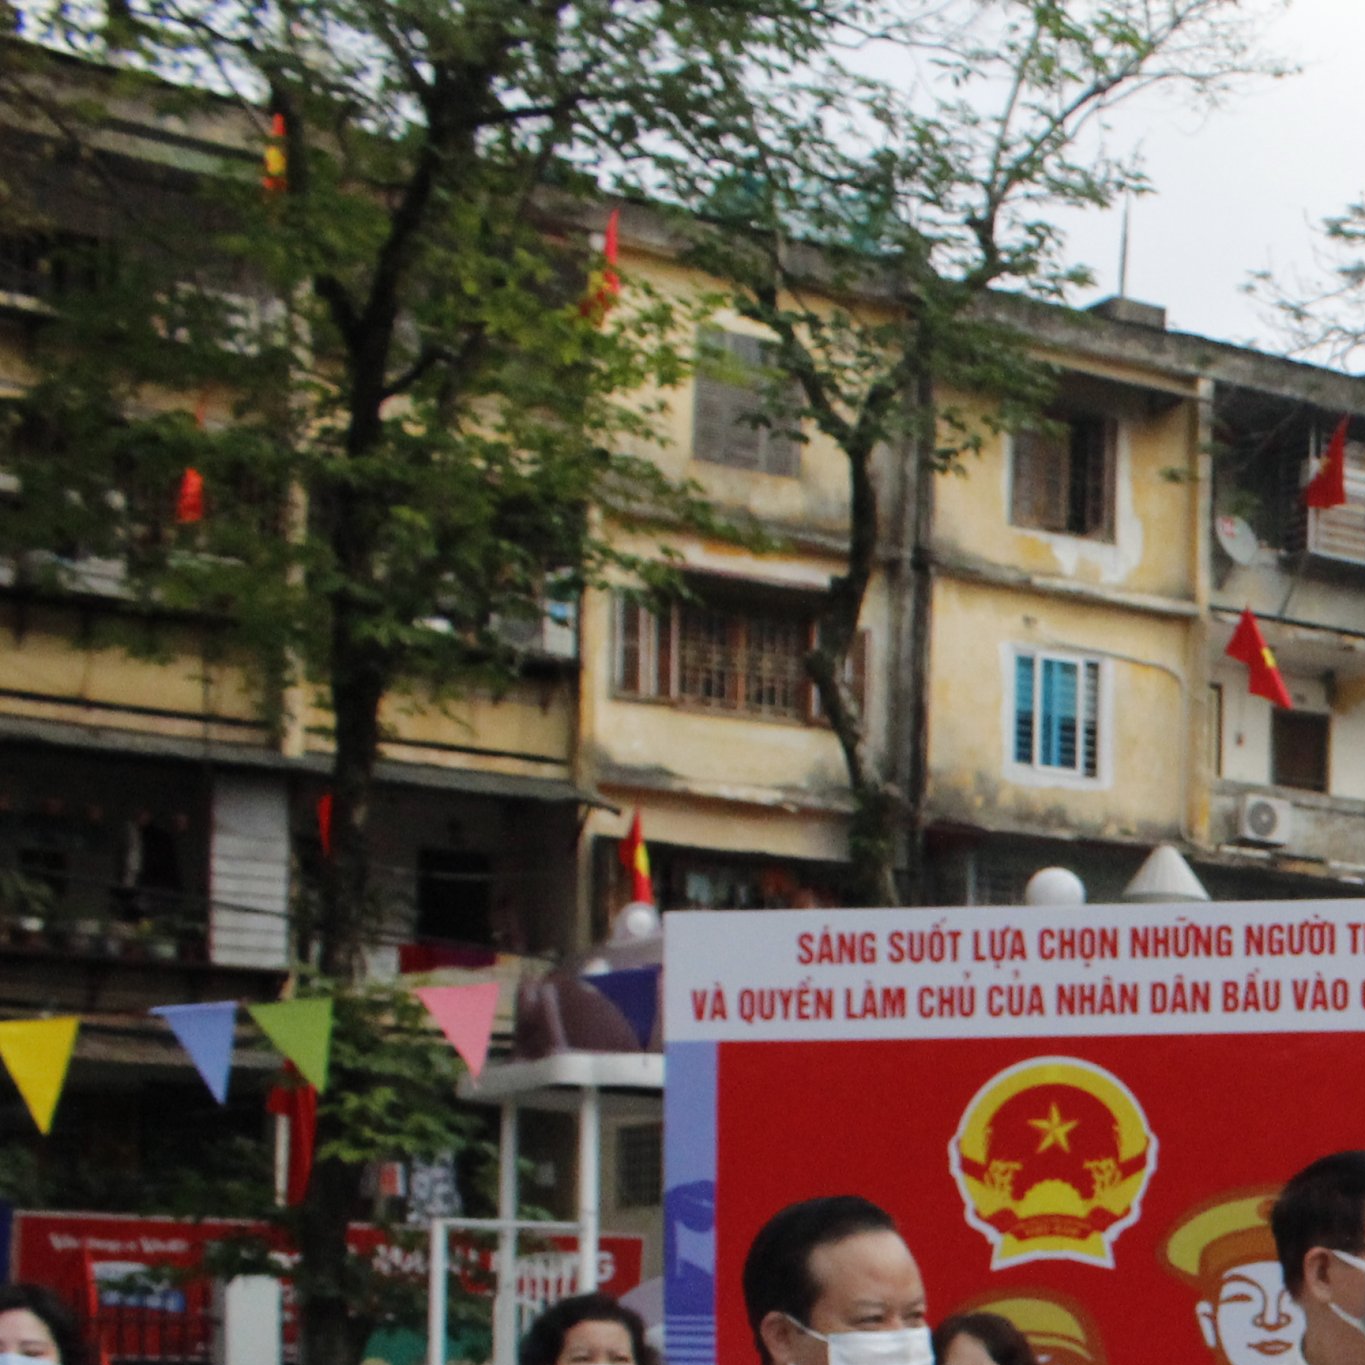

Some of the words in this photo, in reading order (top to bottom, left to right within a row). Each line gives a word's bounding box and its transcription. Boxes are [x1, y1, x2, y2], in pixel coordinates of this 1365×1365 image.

[797, 925, 877, 965] SÁNG
[888, 918, 963, 963] SUỐT
[973, 925, 1028, 969] LỰA
[1038, 927, 1119, 968] CHỌN
[1130, 917, 1233, 958] NHỮNG
[1245, 914, 1336, 956] NGƯỜI
[691, 982, 728, 1021] VÀ
[738, 976, 834, 1024] QUYỀN
[845, 981, 907, 1019] LÀM
[918, 971, 976, 1019] CHỦ
[988, 969, 1046, 1017] CỦA
[1057, 975, 1139, 1015] NHÂN
[1150, 974, 1211, 1014] DÂN
[1222, 968, 1281, 1013] BẦU
[1292, 972, 1349, 1012] VÀO
